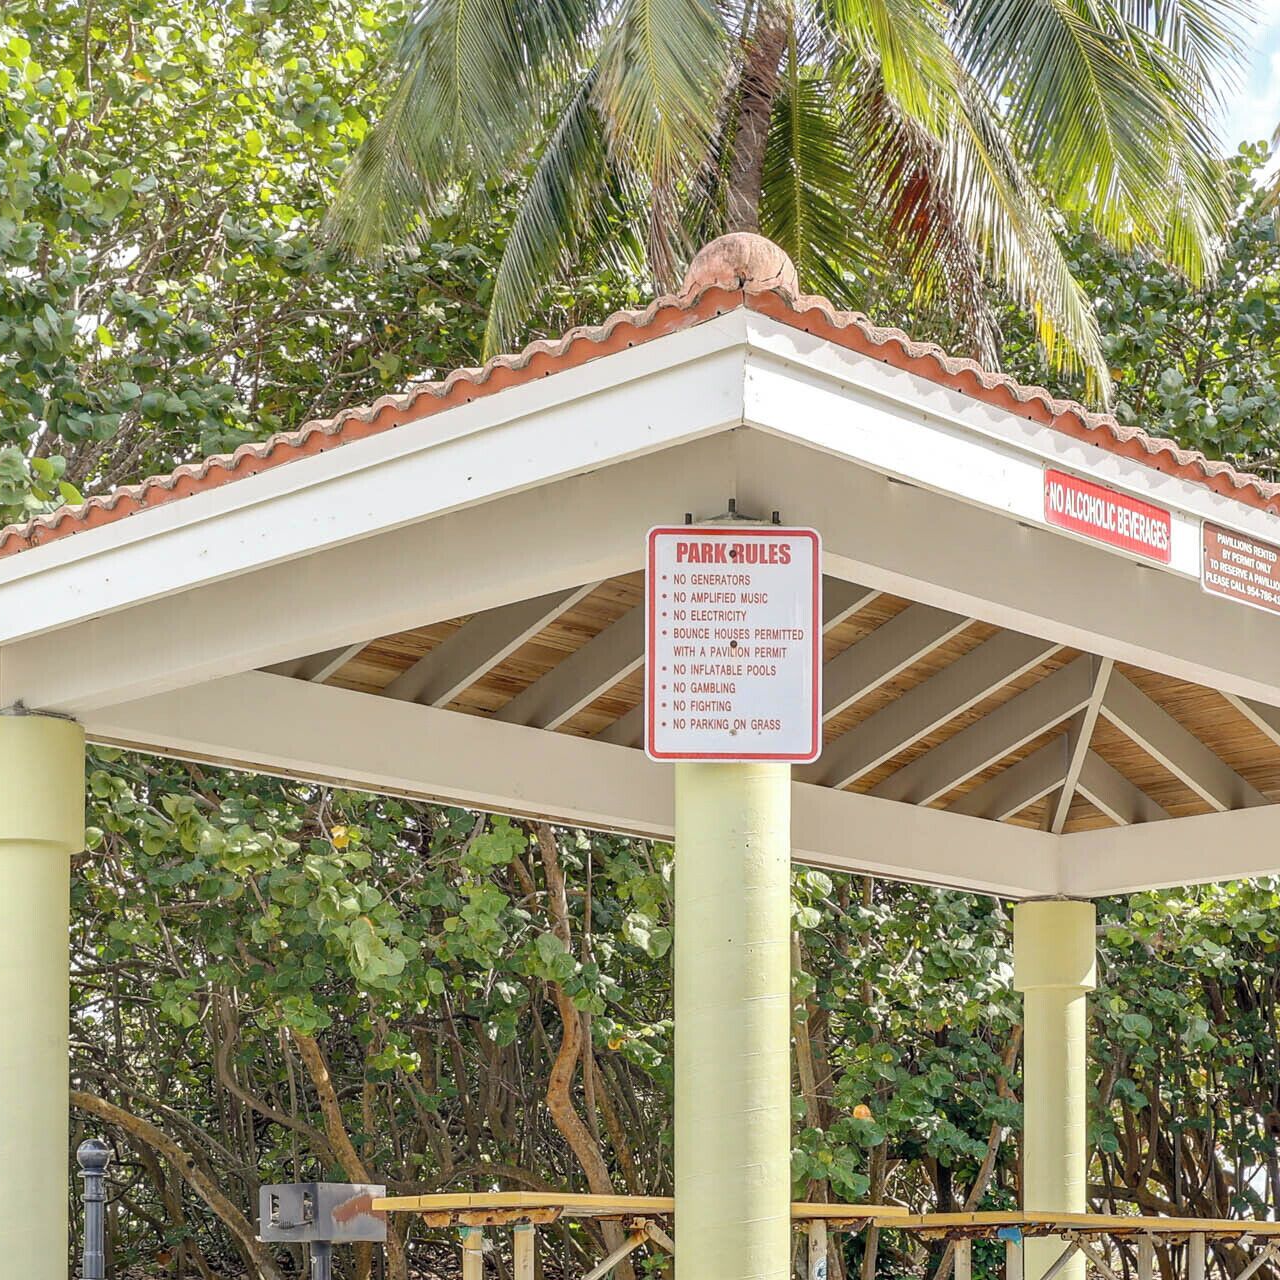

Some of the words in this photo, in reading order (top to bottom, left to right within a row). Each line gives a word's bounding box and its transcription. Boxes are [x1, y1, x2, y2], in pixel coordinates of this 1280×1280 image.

[1049, 481, 1064, 513] NO
[1065, 488, 1116, 531] ALCOHOLIC
[1117, 506, 1168, 550] BEVERAGES
[676, 542, 727, 564] PARK
[733, 543, 791, 564] RULES
[1217, 533, 1252, 554] PAVILLIONS
[1253, 545, 1277, 562] RENTED
[1222, 548, 1231, 561] BY
[1231, 552, 1256, 569] PERMIT
[1255, 561, 1272, 574] ONLY
[1210, 558, 1219, 570] TO
[1220, 561, 1248, 580] RESERVE
[1248, 572, 1254, 582] A
[673, 574, 687, 585] NO
[690, 574, 751, 586] GENERATORS
[1206, 571, 1230, 588] PLEASE
[1230, 580, 1247, 595] CALL
[673, 592, 687, 603] NO
[690, 592, 736, 604] AMPLIFIED
[740, 592, 768, 604] MUSIC
[673, 610, 687, 621] NO
[690, 610, 747, 622] ELECTRICITY
[673, 628, 710, 639] BOUNCE
[714, 628, 750, 640] HOUSES
[754, 629, 804, 641] PERMITTED
[673, 646, 696, 657] WITH
[700, 647, 706, 657] A
[710, 647, 750, 658] PAVILION
[754, 647, 787, 659] PERMIT
[673, 664, 687, 675] NO
[690, 664, 743, 676] INFLATABLE
[746, 665, 777, 676] POOLS
[673, 682, 687, 693] NO
[690, 682, 736, 694] GAMBLING
[673, 700, 687, 711] NO
[690, 700, 732, 712] FIGHTING
[673, 718, 686, 730] NO
[690, 718, 729, 730] PARKING
[733, 719, 747, 730] ON
[750, 719, 781, 731] GRASS
